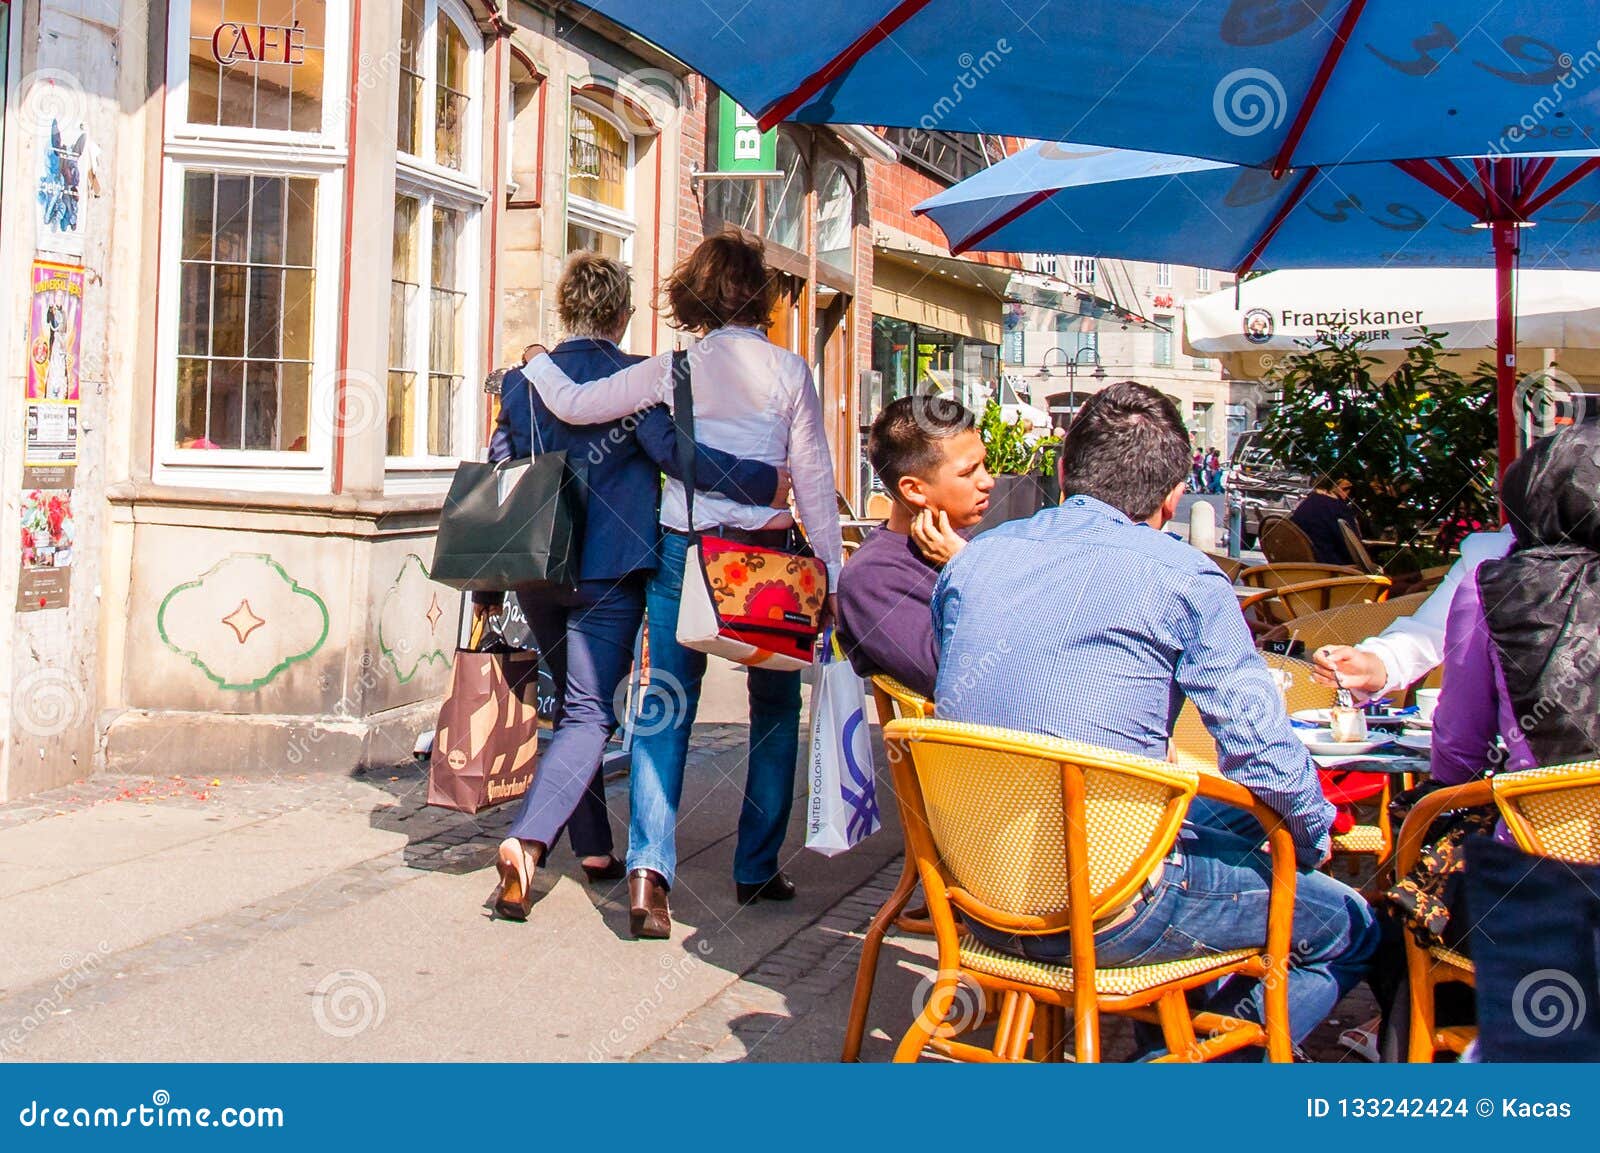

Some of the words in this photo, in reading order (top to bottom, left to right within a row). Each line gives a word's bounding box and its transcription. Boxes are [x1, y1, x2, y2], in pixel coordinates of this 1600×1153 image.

[212, 20, 305, 65] CAFÉ
[1281, 308, 1424, 327] Franziskaner
[813, 752, 822, 795] COLORS
[811, 796, 822, 834] UNITED
